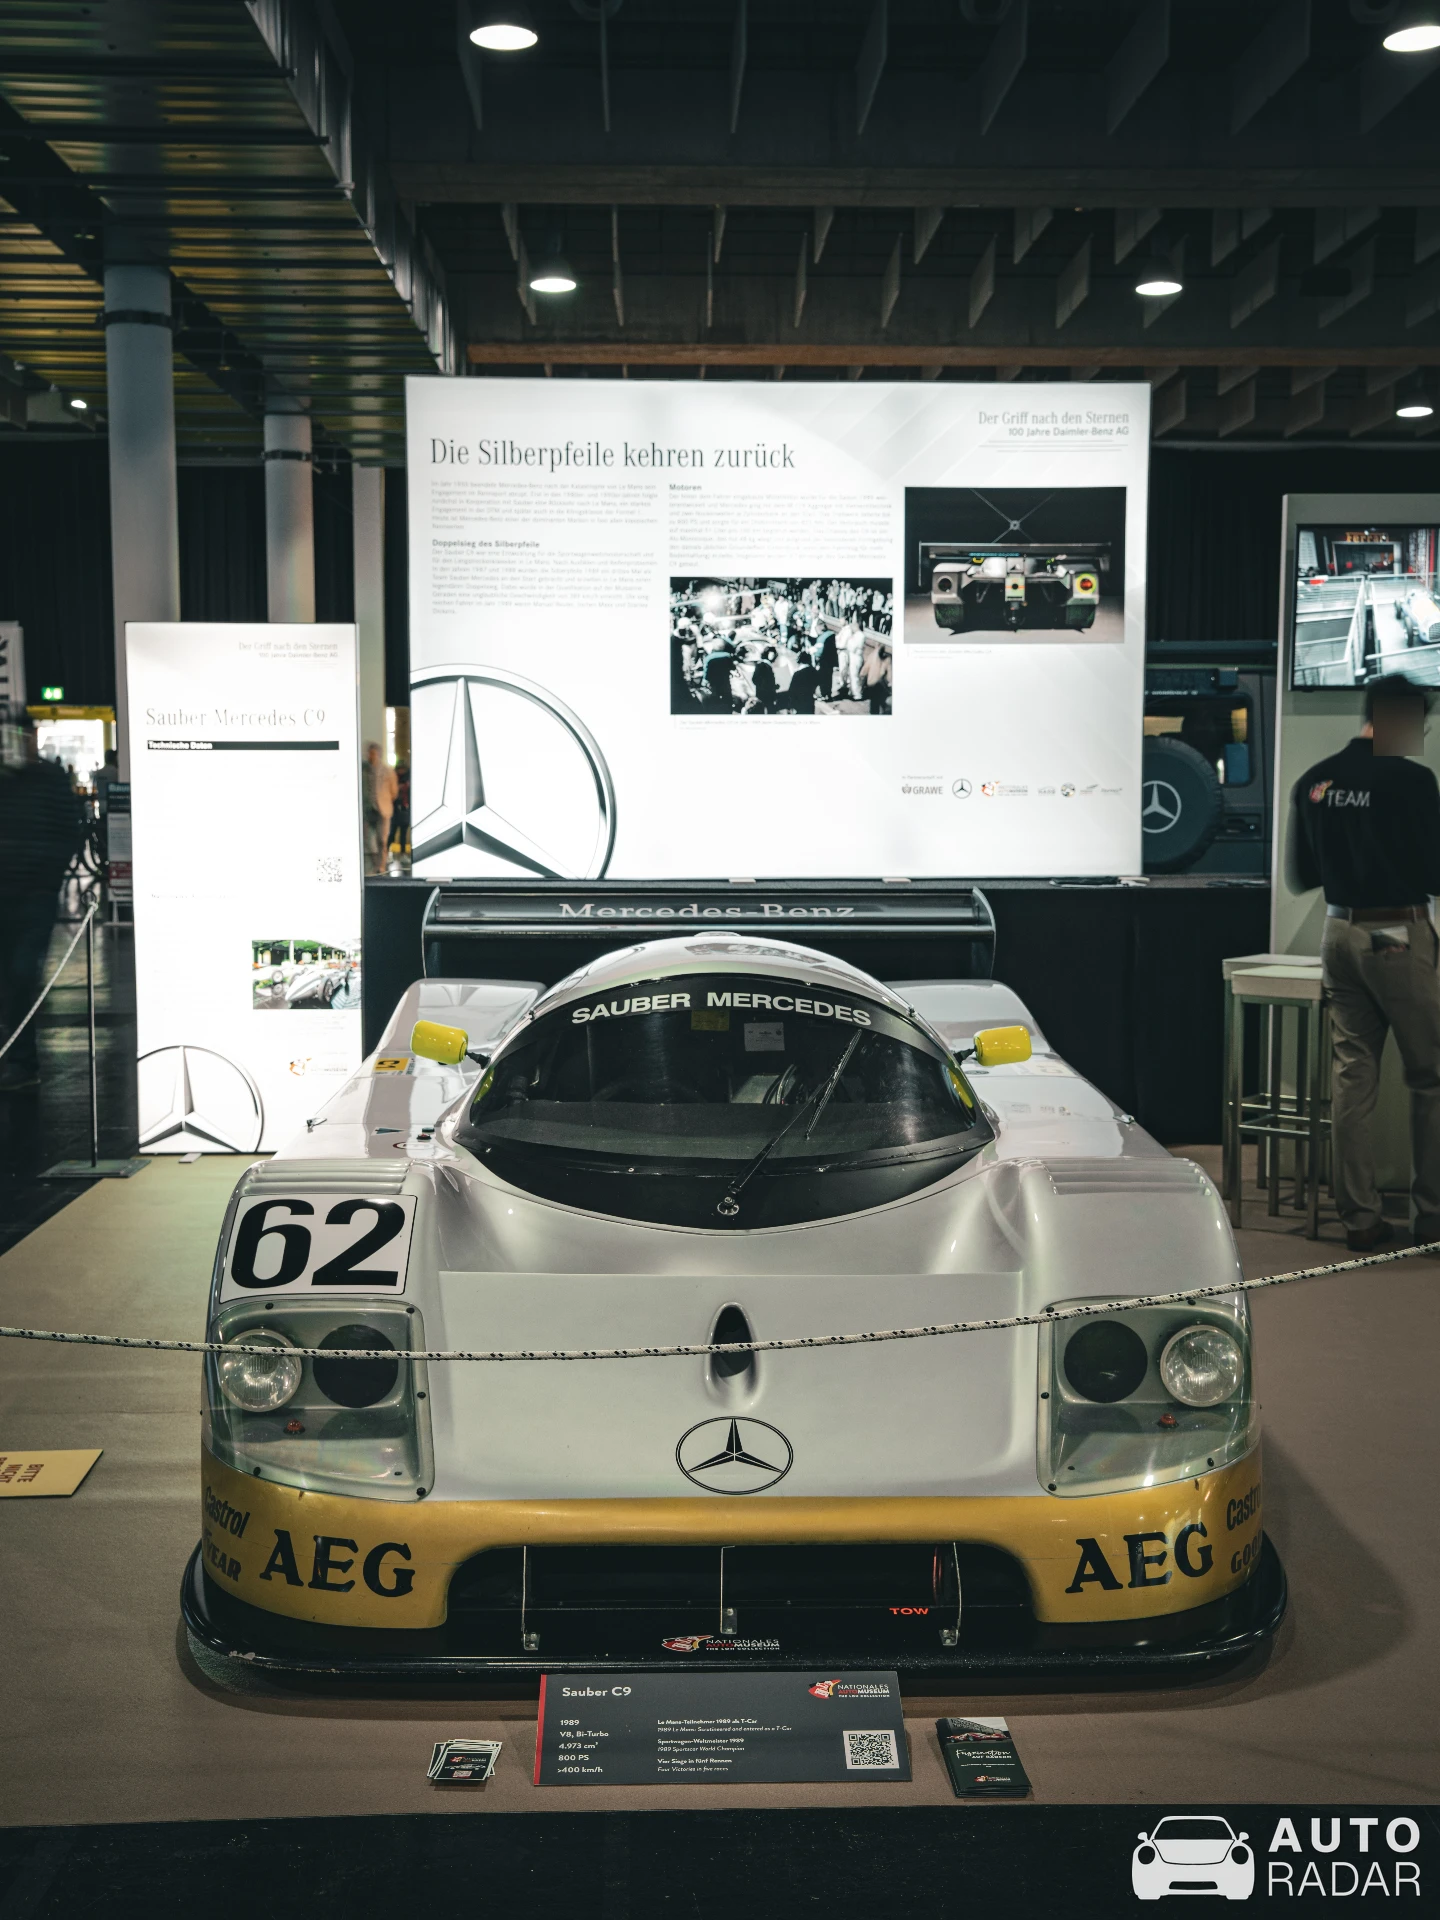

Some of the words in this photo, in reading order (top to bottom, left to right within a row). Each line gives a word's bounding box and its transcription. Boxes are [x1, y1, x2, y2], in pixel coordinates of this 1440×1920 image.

[979, 411, 999, 424] Der
[1002, 411, 1028, 424] Griff
[1032, 411, 1058, 424] nach
[1062, 411, 1082, 424] den
[1086, 411, 1130, 424] Sternen
[1008, 427, 1024, 436] 100
[1026, 427, 1050, 437] Jahre
[1053, 426, 1113, 436] Daimler-Benz
[1116, 426, 1129, 436] AG
[430, 438, 469, 464] Die
[478, 439, 614, 472] Silberpfeile
[623, 442, 704, 468] kehren
[714, 442, 795, 468] zurück
[432, 539, 476, 548] Doppelsieg
[495, 540, 540, 549] Silberpfeile
[146, 708, 206, 726] Sauber
[215, 708, 296, 726] Mercedes
[303, 708, 326, 727] C9
[913, 786, 944, 796] GRAWE
[1326, 790, 1370, 807] TEAM
[558, 903, 855, 918] Mercedes-Benz
[572, 993, 691, 1024] SAUBER
[706, 992, 872, 1026] MERCEDES
[231, 1198, 406, 1289] 62
[204, 1486, 250, 1538] Castrol
[260, 1528, 416, 1598] AEG
[1065, 1522, 1214, 1594] AEG
[562, 1686, 608, 1697] Sauber
[611, 1686, 632, 1696] C9
